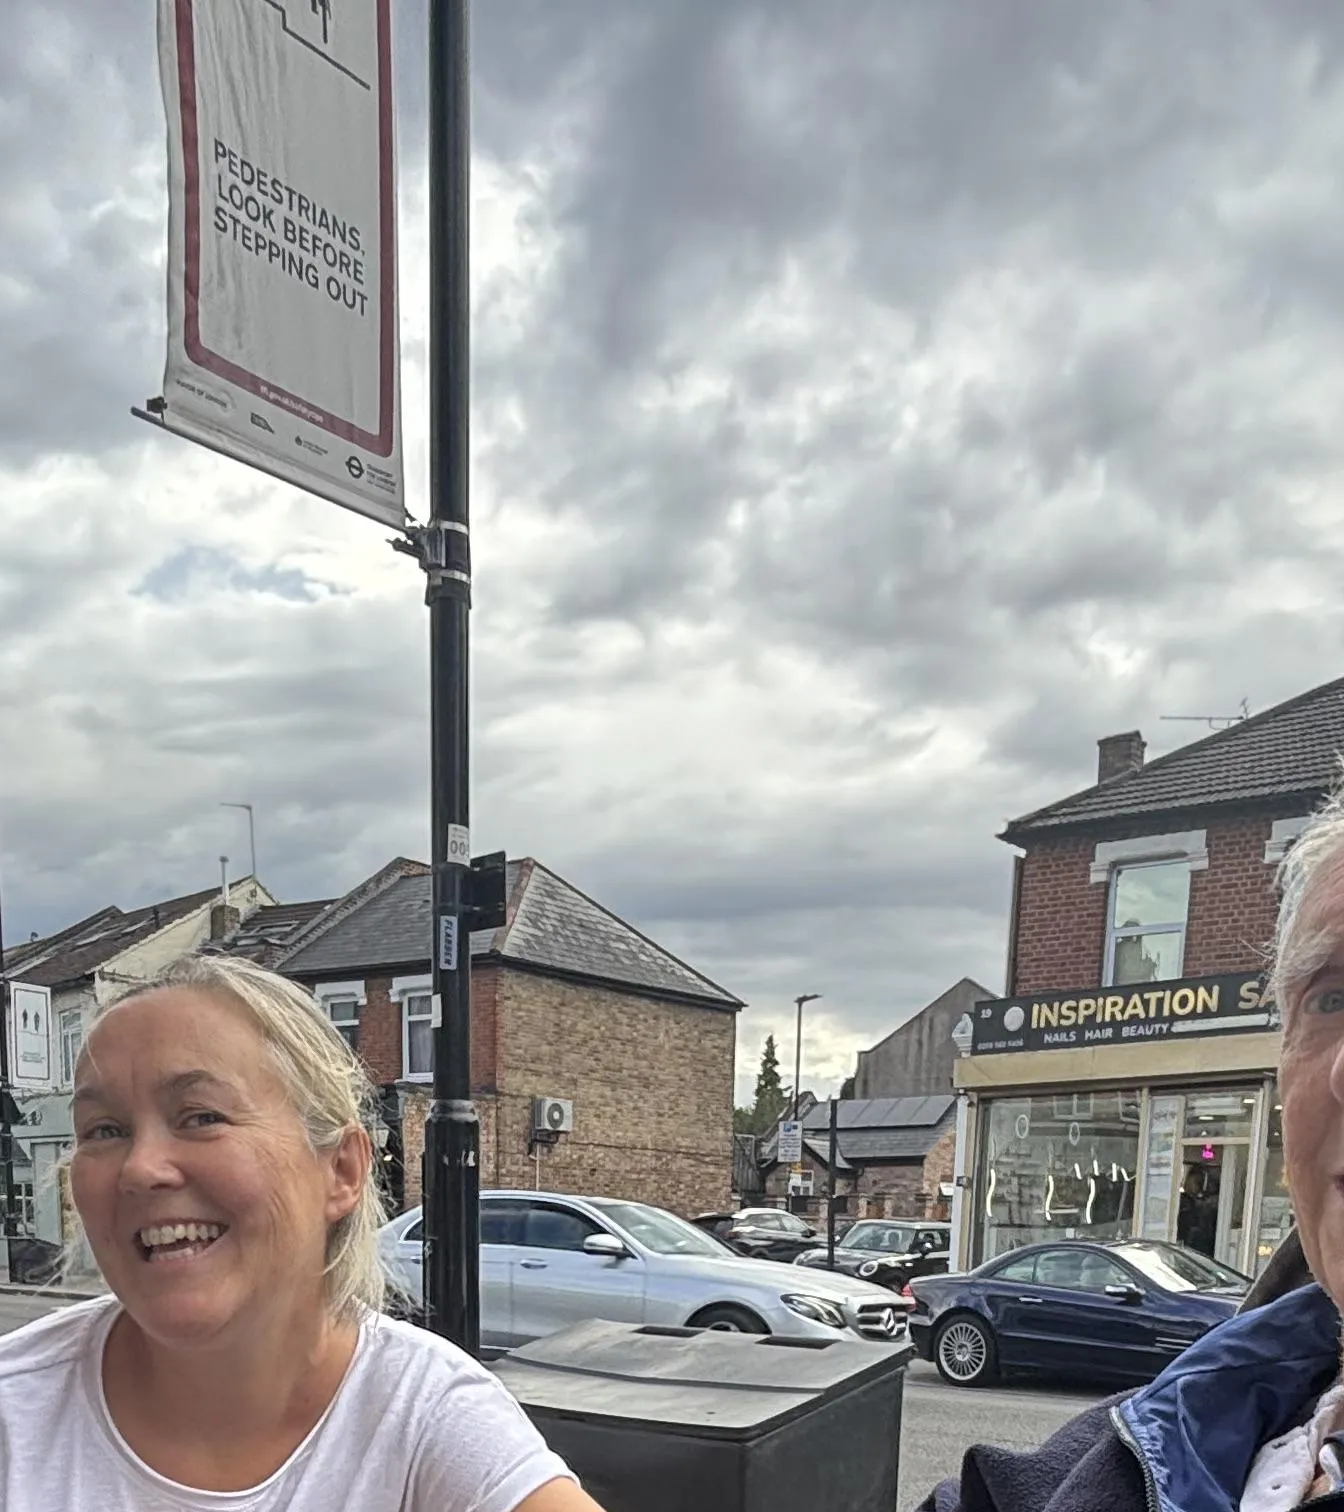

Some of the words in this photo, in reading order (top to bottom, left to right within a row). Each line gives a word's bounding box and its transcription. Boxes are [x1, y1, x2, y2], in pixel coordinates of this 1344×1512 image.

[214, 137, 366, 257] PEDESTRIANS,
[218, 173, 276, 234] LOOK
[283, 215, 364, 286] BEFORE
[213, 205, 320, 290] STEPPING
[326, 276, 368, 317] OUT
[1031, 984, 1221, 1030] INSPIRATION
[1238, 980, 1275, 1010] SA
[1043, 1030, 1077, 1044] NAILS
[1084, 1027, 1113, 1040] HAIR
[1121, 1023, 1169, 1038] BEAUTY
